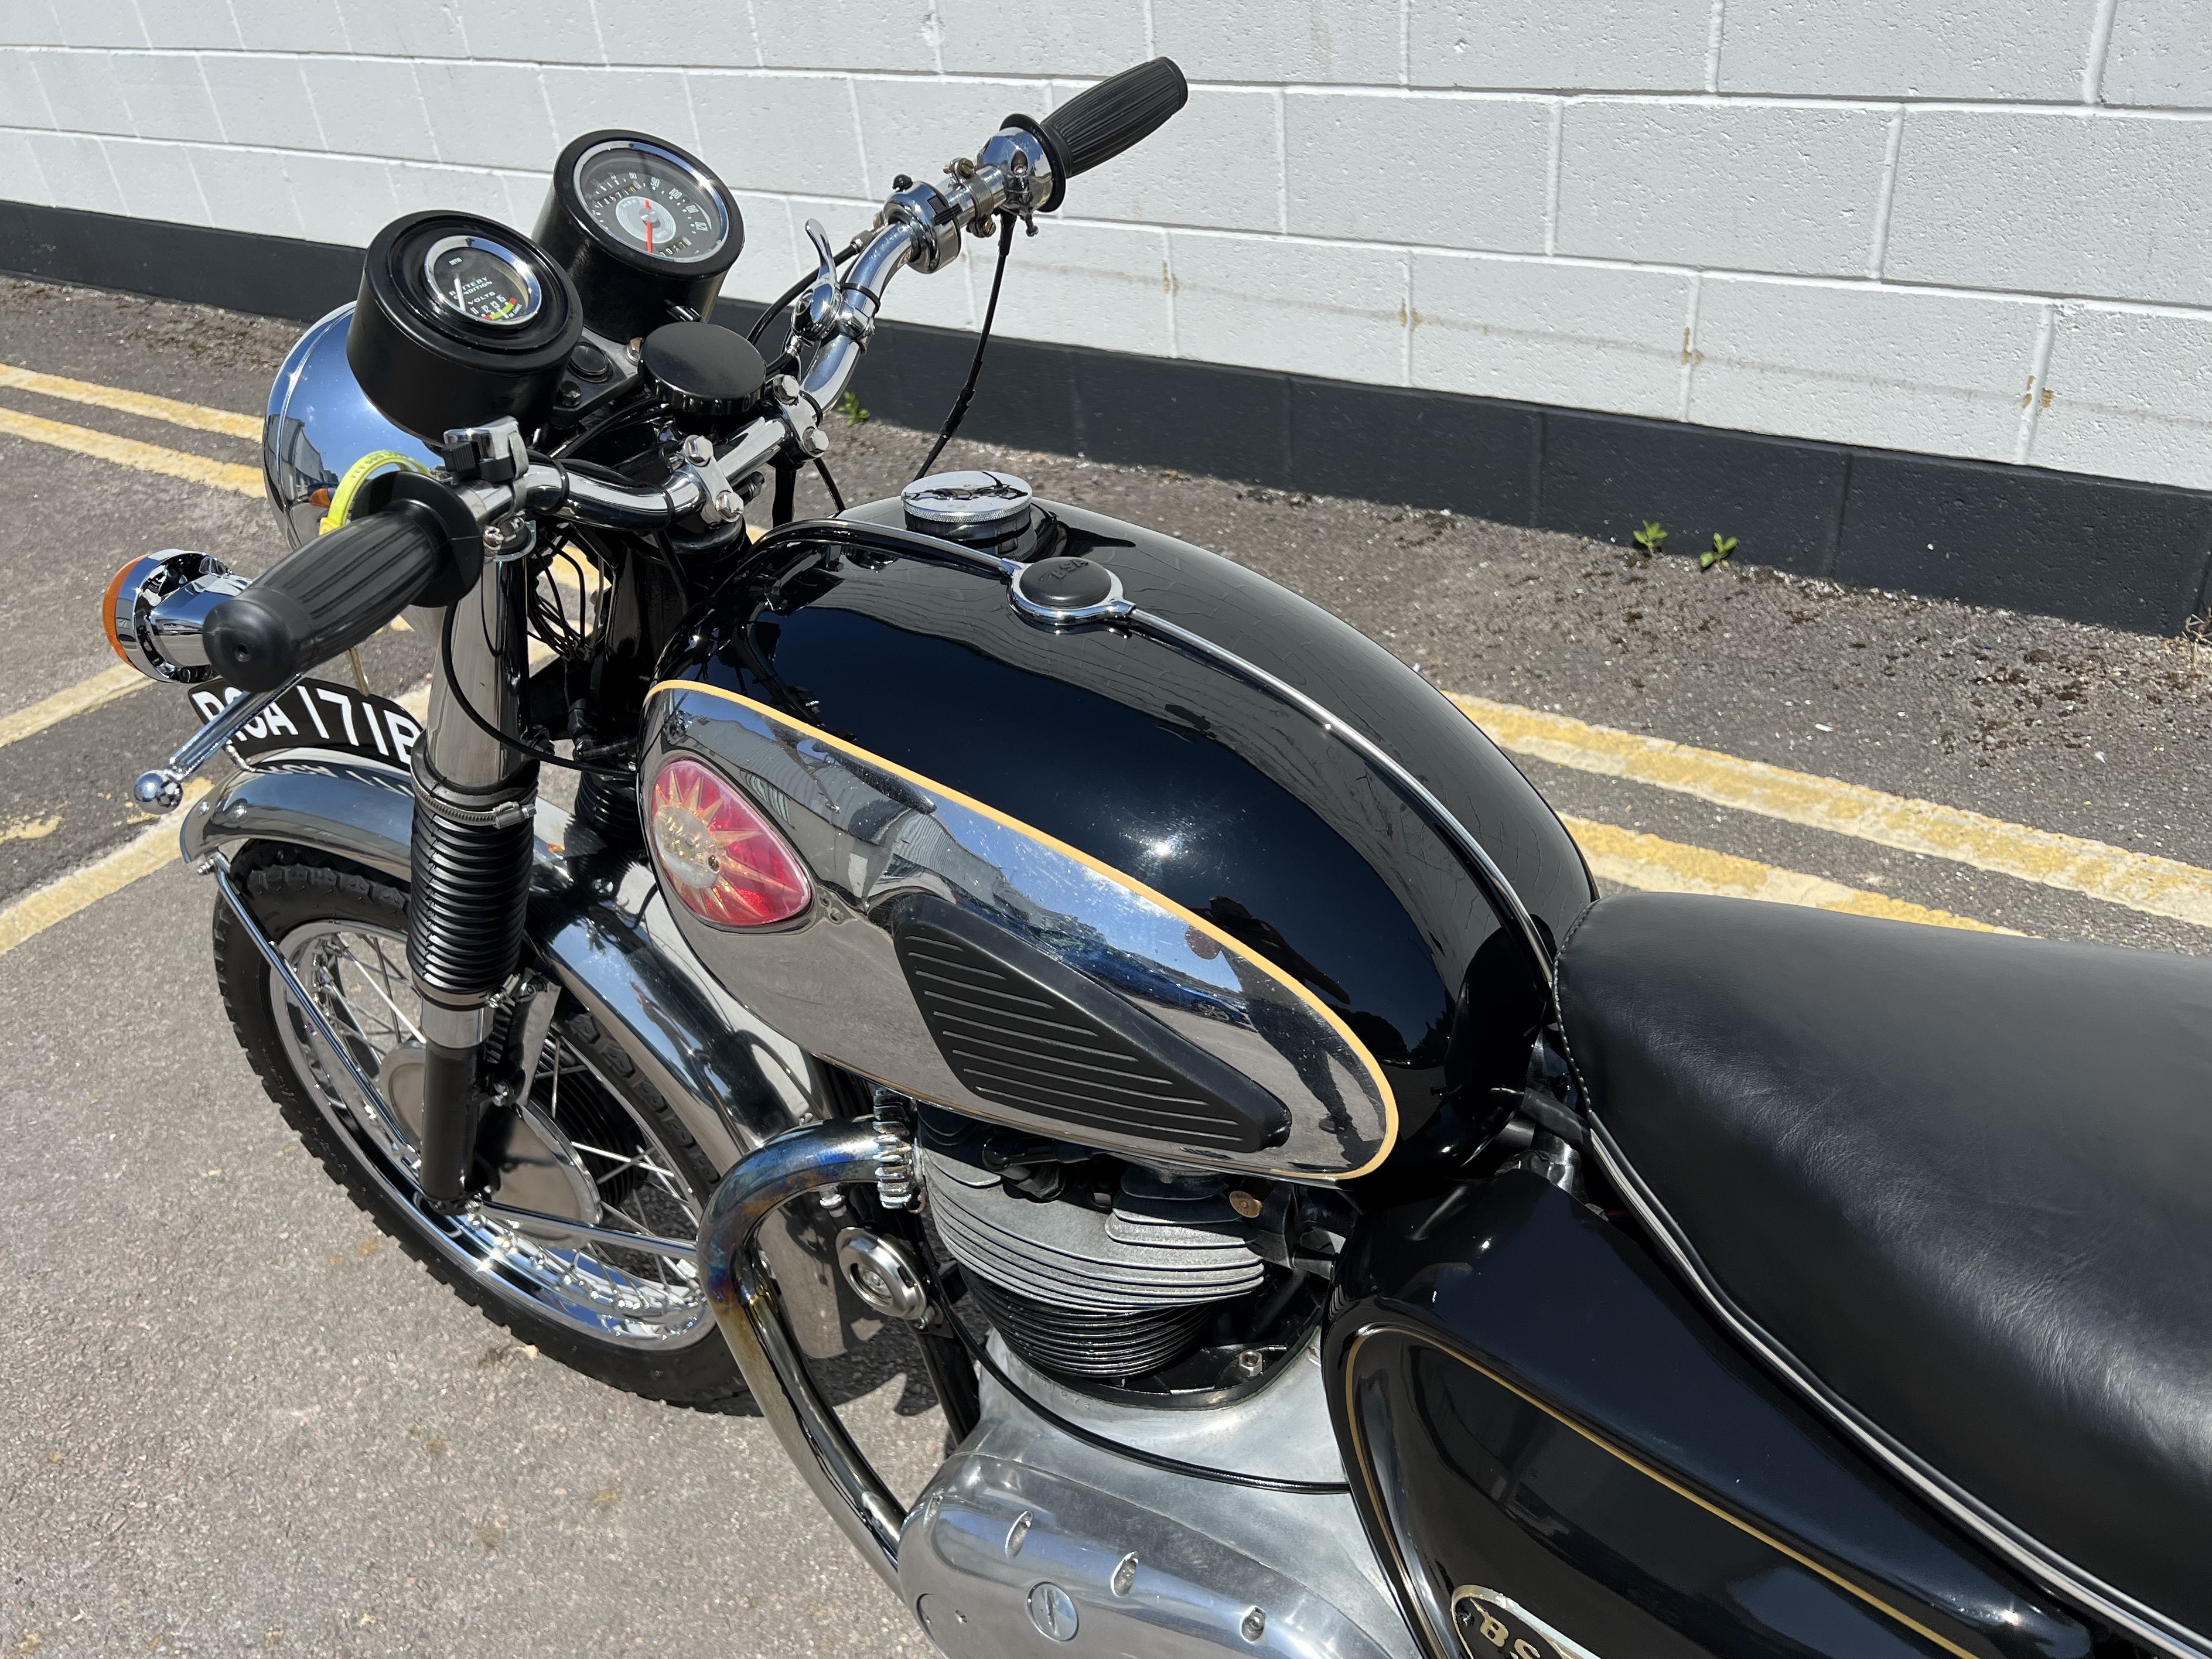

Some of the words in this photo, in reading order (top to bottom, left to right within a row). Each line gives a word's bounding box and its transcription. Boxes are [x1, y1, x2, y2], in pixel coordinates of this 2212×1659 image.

[650, 177, 660, 187] 90
[669, 188, 682, 199] 100
[449, 276, 488, 296] BTTERY
[453, 281, 493, 299] CNDITION
[467, 291, 496, 305] VOLTS
[470, 306, 479, 315] 11
[481, 305, 491, 313] 12
[296, 685, 420, 765] 171B
